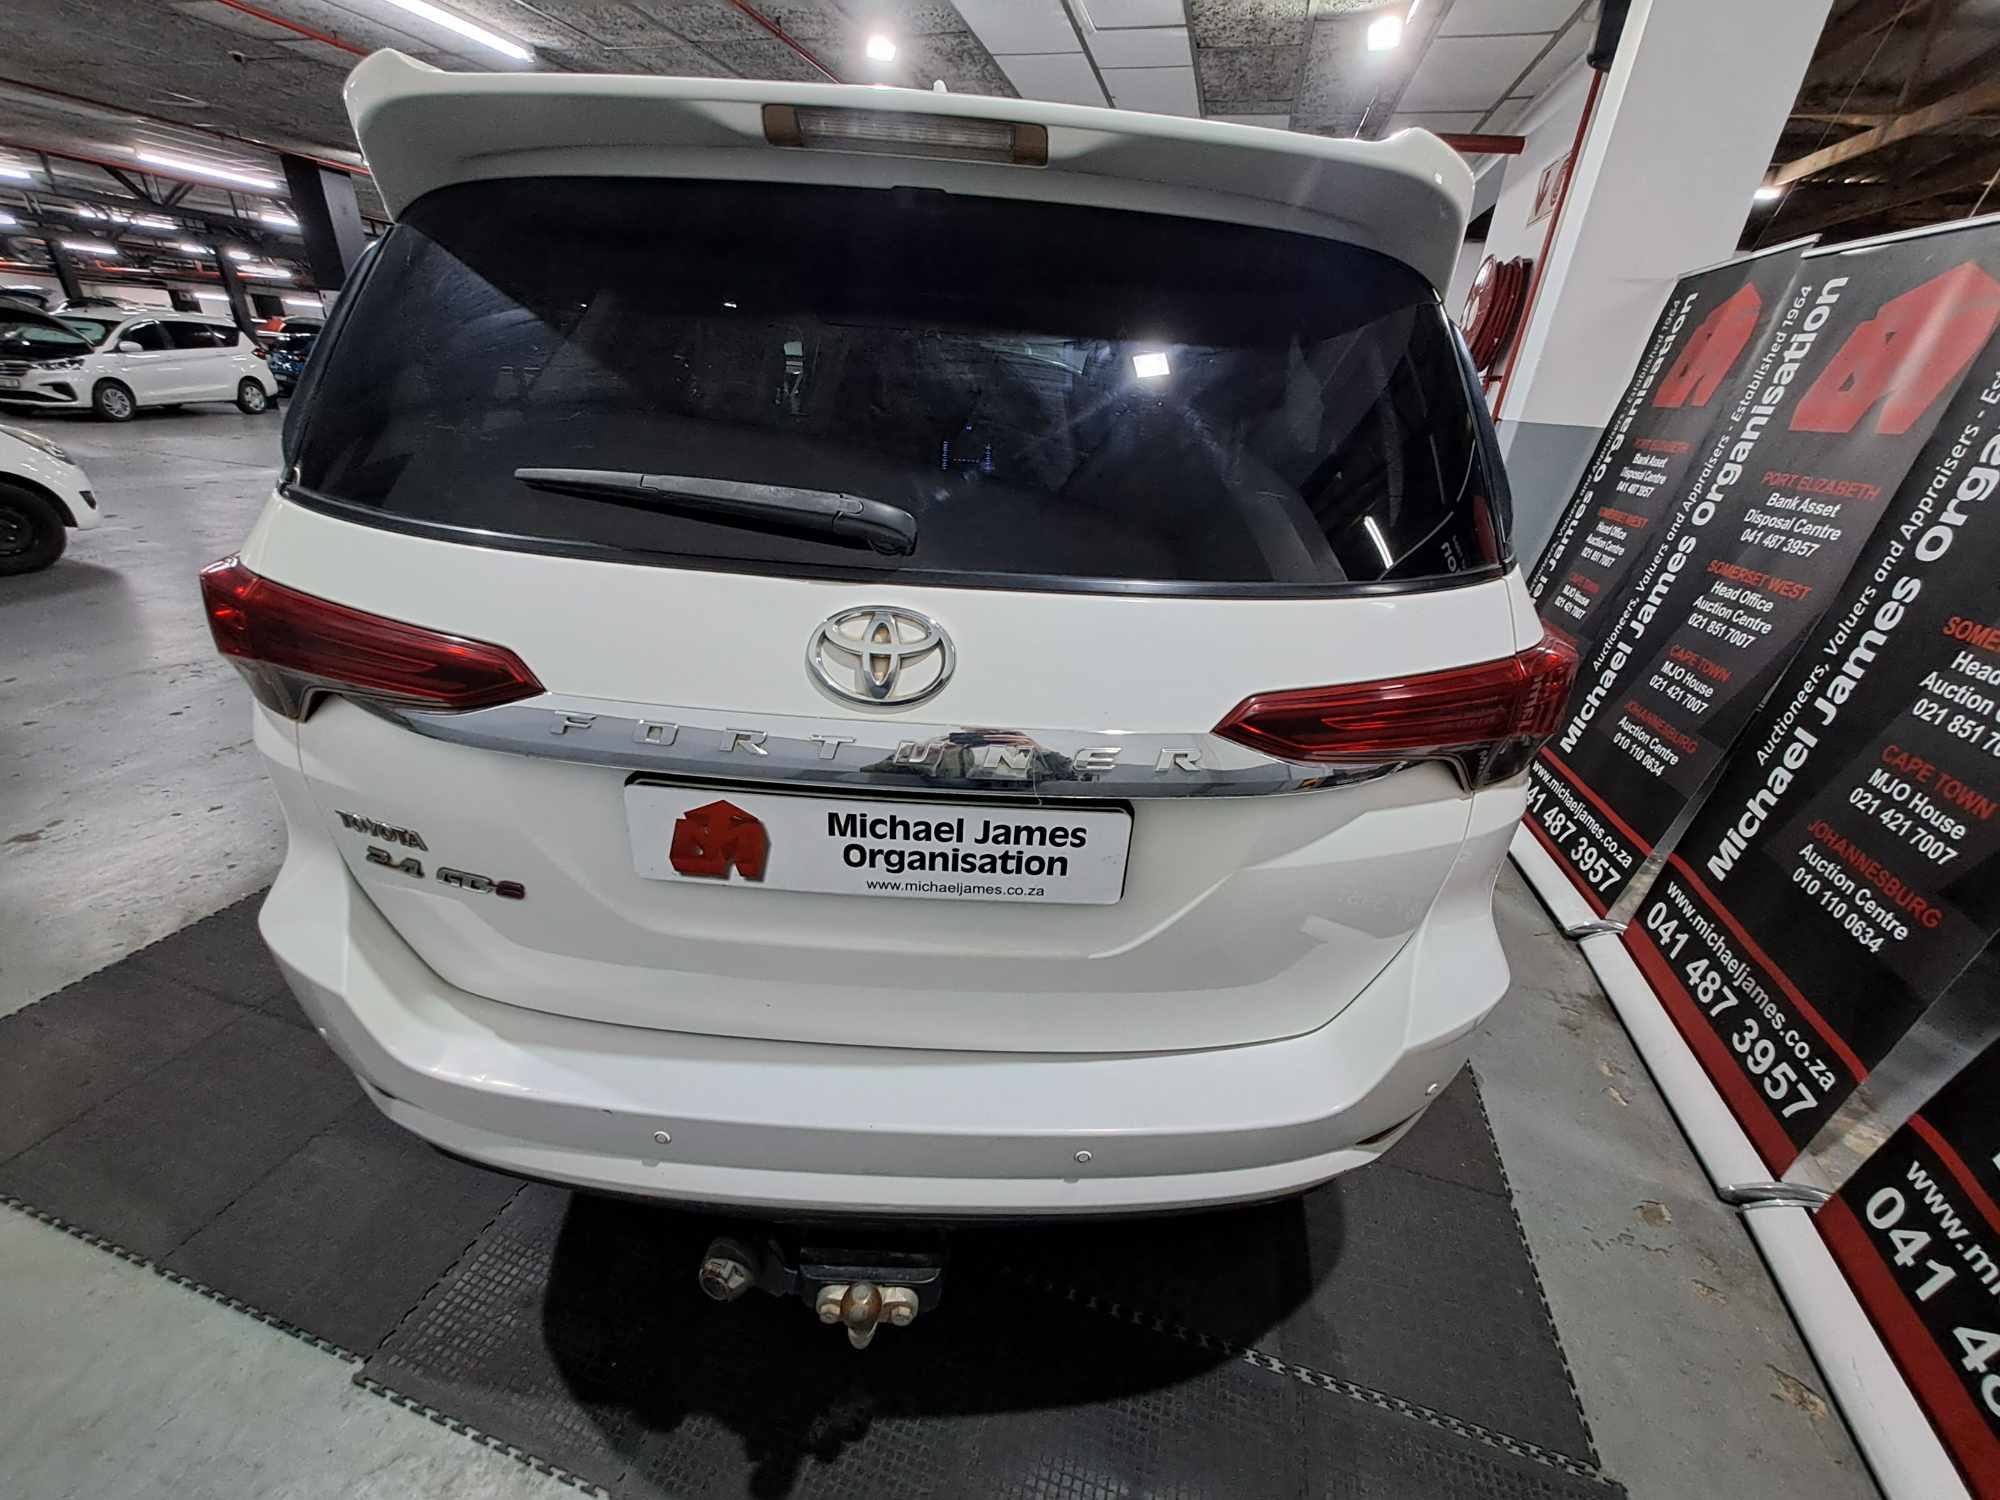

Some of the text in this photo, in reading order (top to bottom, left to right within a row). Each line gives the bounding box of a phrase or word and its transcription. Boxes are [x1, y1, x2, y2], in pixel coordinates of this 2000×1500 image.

[1549, 491, 1593, 571] James
[1594, 293, 1698, 482] Organisation
[1593, 597, 1640, 671] Auctioneers,
[1636, 543, 1668, 592] Valuers
[1667, 513, 1685, 541] and
[1683, 434, 1730, 512] Appraisers
[1731, 331, 1787, 422] Established
[1782, 285, 1813, 327] 1964
[1766, 493, 1842, 518] Bank Asset
[1559, 641, 1633, 753] Michael
[1629, 535, 1697, 639] James
[1691, 277, 1849, 526] Organisation
[1740, 528, 1821, 558] 041 487 3957
[1744, 509, 1842, 541] Disposal Centre
[1707, 560, 1812, 600] SOMERSET WEST
[1711, 581, 1774, 613] Head Office
[1755, 662, 1830, 766] Auctioneers,
[1823, 586, 1876, 657] Valuers
[1874, 540, 1905, 582] and
[1900, 424, 1980, 540] Appraisers
[1688, 613, 1756, 648] 021 851 7007
[1693, 596, 1773, 634] Auction Centre
[1650, 675, 1709, 715] 021 421 7007
[1661, 661, 1714, 697] MJO House
[1919, 671, 1994, 715] Auction
[550, 709, 1202, 778] FORTUNER
[1618, 716, 1679, 765] Auction Centre
[1706, 726, 1819, 882] Michael
[1813, 576, 1922, 726] James
[1912, 698, 1949, 725] 021
[1947, 714, 1985, 743] 851
[1613, 732, 1665, 777] 010 110 0634
[1881, 744, 1998, 821] CAPE TOWN
[335, 809, 429, 851] TOYOTA
[827, 812, 1087, 848] Michael James
[1532, 760, 1632, 868] www.michaeljames.co.za
[1849, 787, 1958, 866] 021 421 7007
[1868, 768, 1966, 840] MJO House
[843, 843, 1069, 876] Organisation
[1527, 776, 1622, 892] 41 487 3957
[866, 879, 1045, 897] www.michaeljames.co.za
[1799, 843, 1909, 941] Auction Centre
[1807, 819, 1942, 930] JOHANNESBURG
[1792, 867, 1885, 953] 010 110 0634
[1647, 902, 1819, 1119] 041 487 3957
[1666, 880, 1836, 1092] www.michaeljames.co.za
[1866, 1187, 1957, 1301] 041
